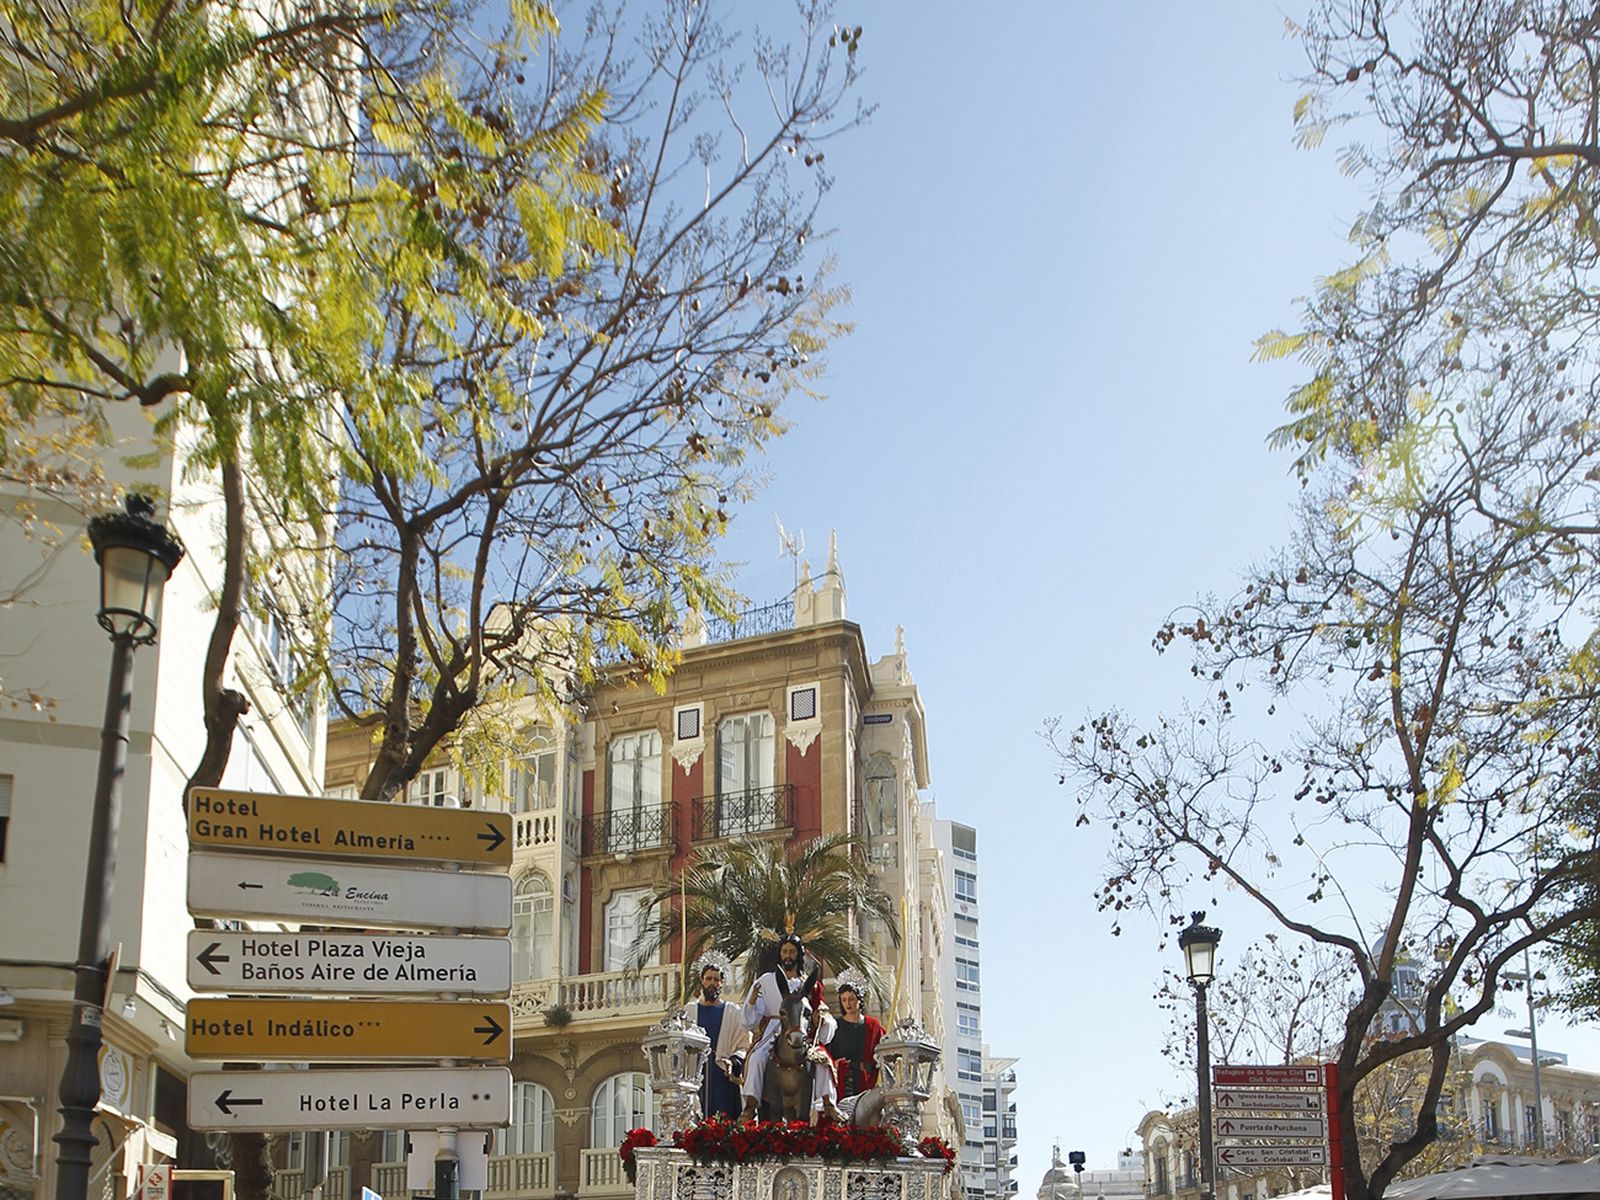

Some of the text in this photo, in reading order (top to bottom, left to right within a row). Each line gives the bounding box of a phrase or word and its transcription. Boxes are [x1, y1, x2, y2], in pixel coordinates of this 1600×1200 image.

[195, 796, 259, 817] Hotel
[195, 819, 415, 851] Gran Hotel Almería
[320, 886, 389, 901] La Encina
[242, 939, 426, 962] Hotel Plaza Vieja
[242, 963, 477, 982] Baños Aire de Almería
[191, 1019, 354, 1037] Hotel Indálico
[300, 1093, 460, 1111] Hotel La Perla
[1240, 1123, 1307, 1132] Puerta de Purchena
